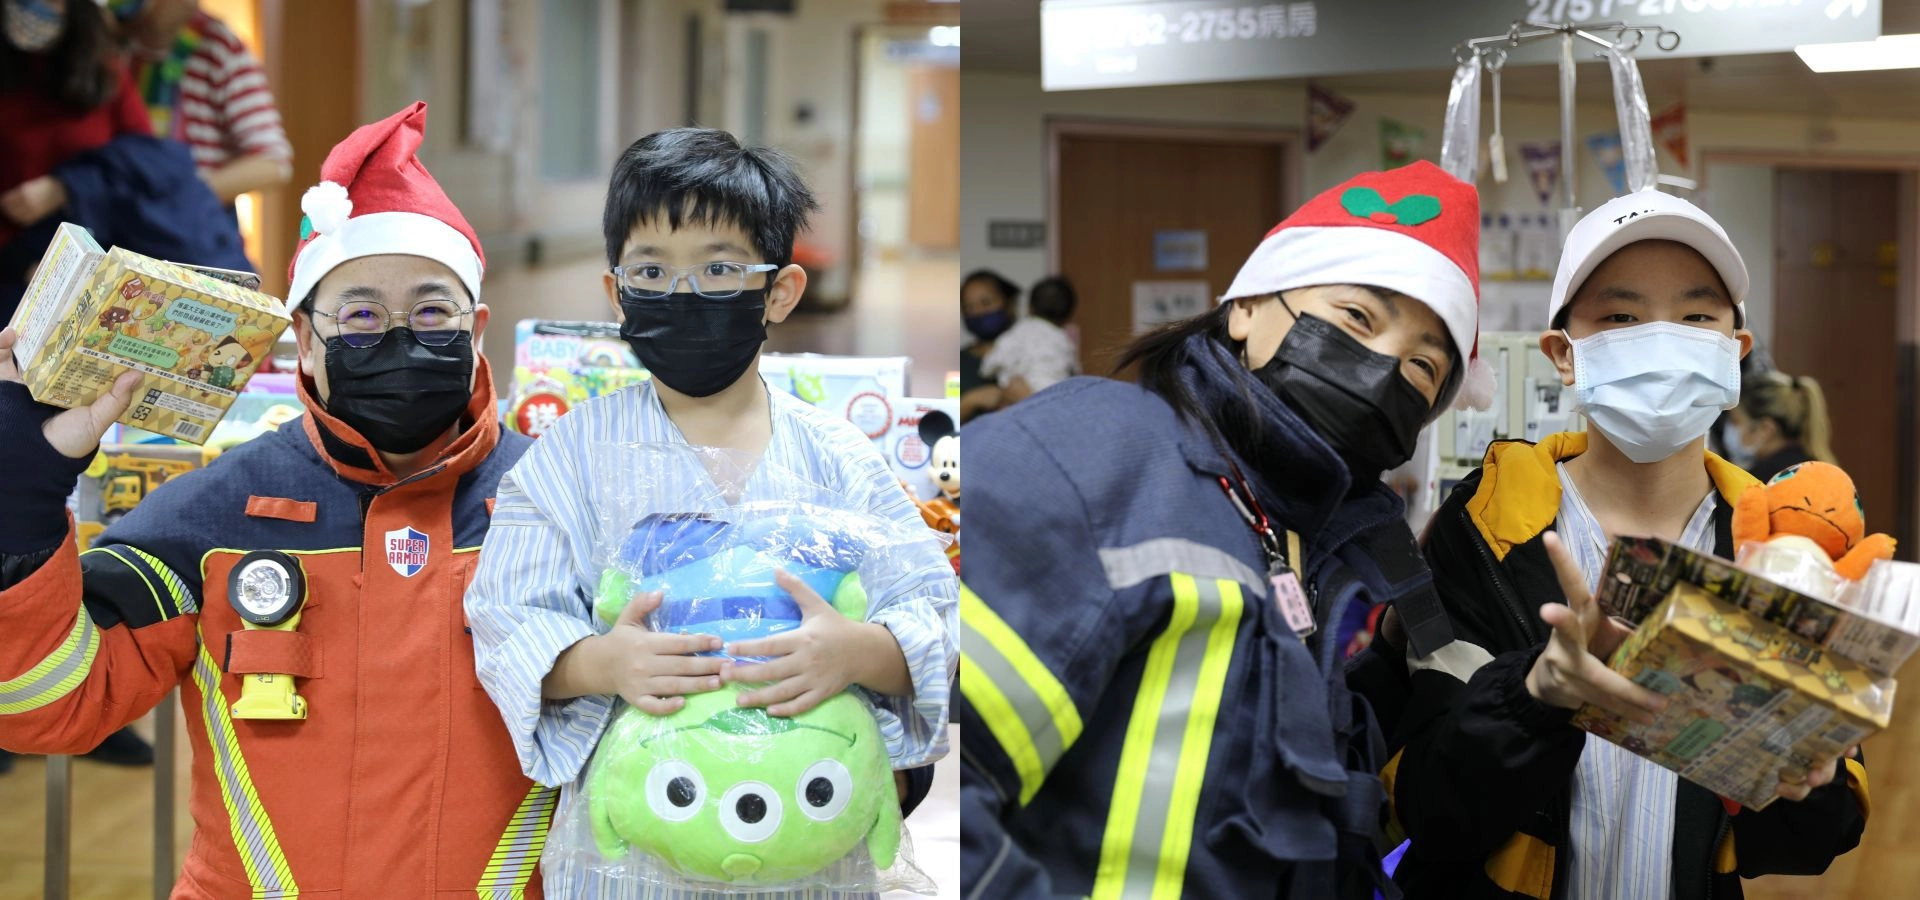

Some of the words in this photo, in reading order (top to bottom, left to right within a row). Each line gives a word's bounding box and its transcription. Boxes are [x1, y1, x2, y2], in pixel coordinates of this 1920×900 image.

[530, 341, 579, 358] BABY
[390, 538, 424, 553] SUPER
[389, 552, 426, 565] ARMOR
